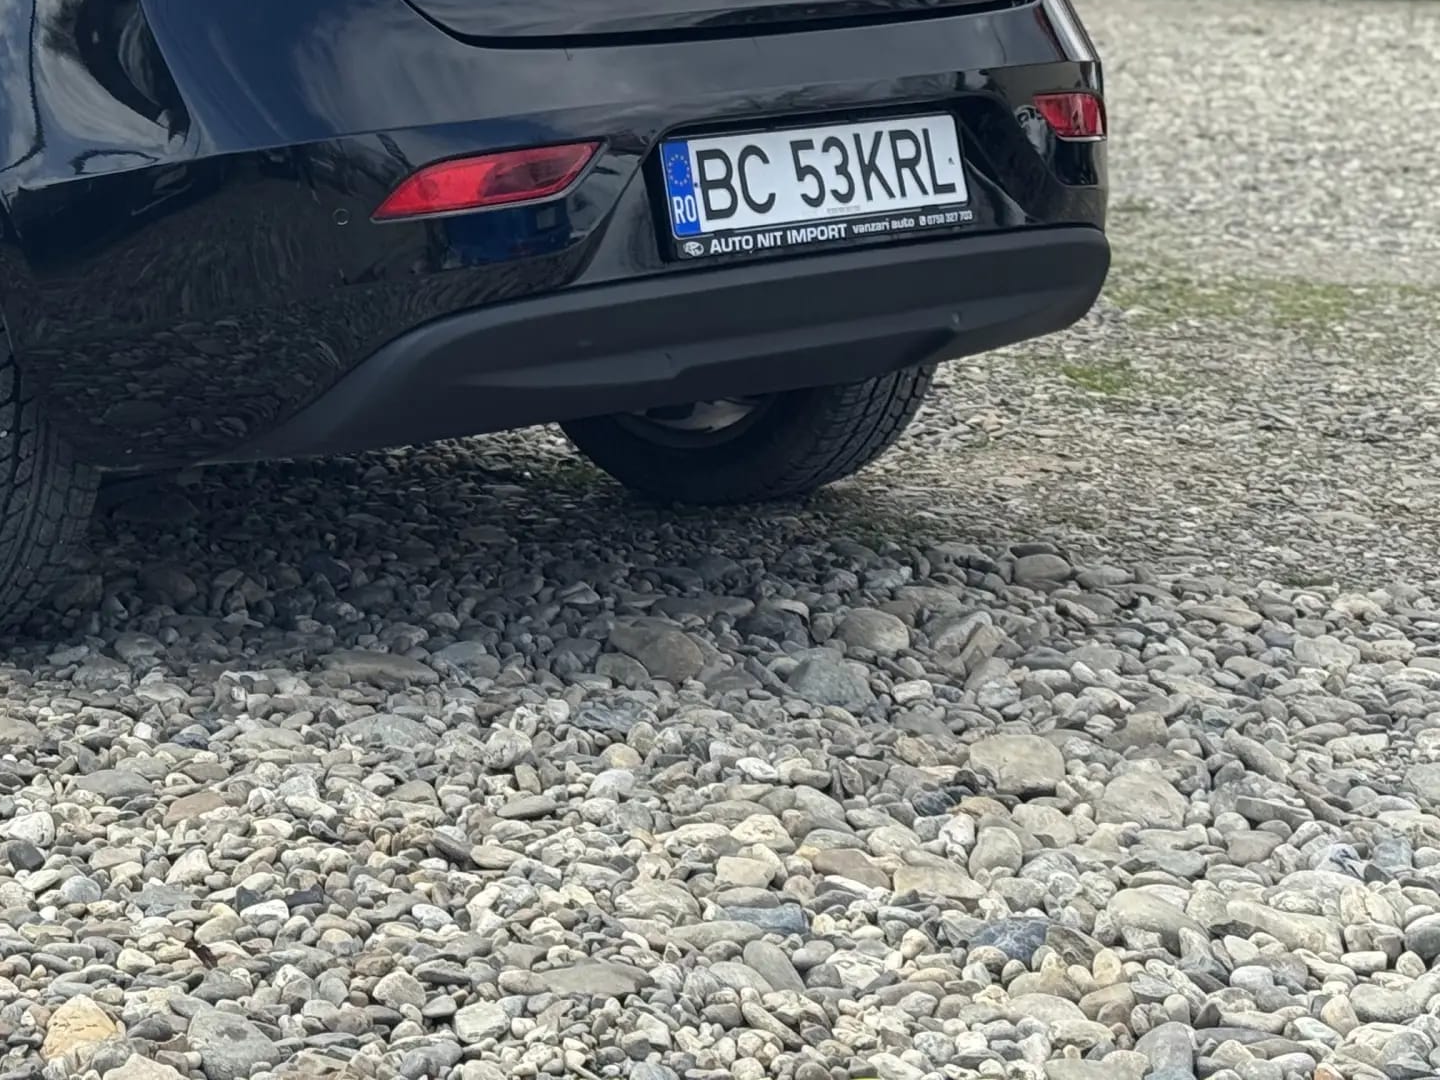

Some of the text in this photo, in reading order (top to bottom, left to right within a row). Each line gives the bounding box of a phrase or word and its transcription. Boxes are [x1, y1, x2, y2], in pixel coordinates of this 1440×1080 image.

[696, 144, 777, 221] BC
[672, 195, 698, 224] RO
[709, 234, 754, 255] AUTO
[757, 231, 782, 249] NIT
[787, 224, 848, 245] IMPORT
[852, 218, 890, 234] vanzari
[891, 218, 915, 230] auto
